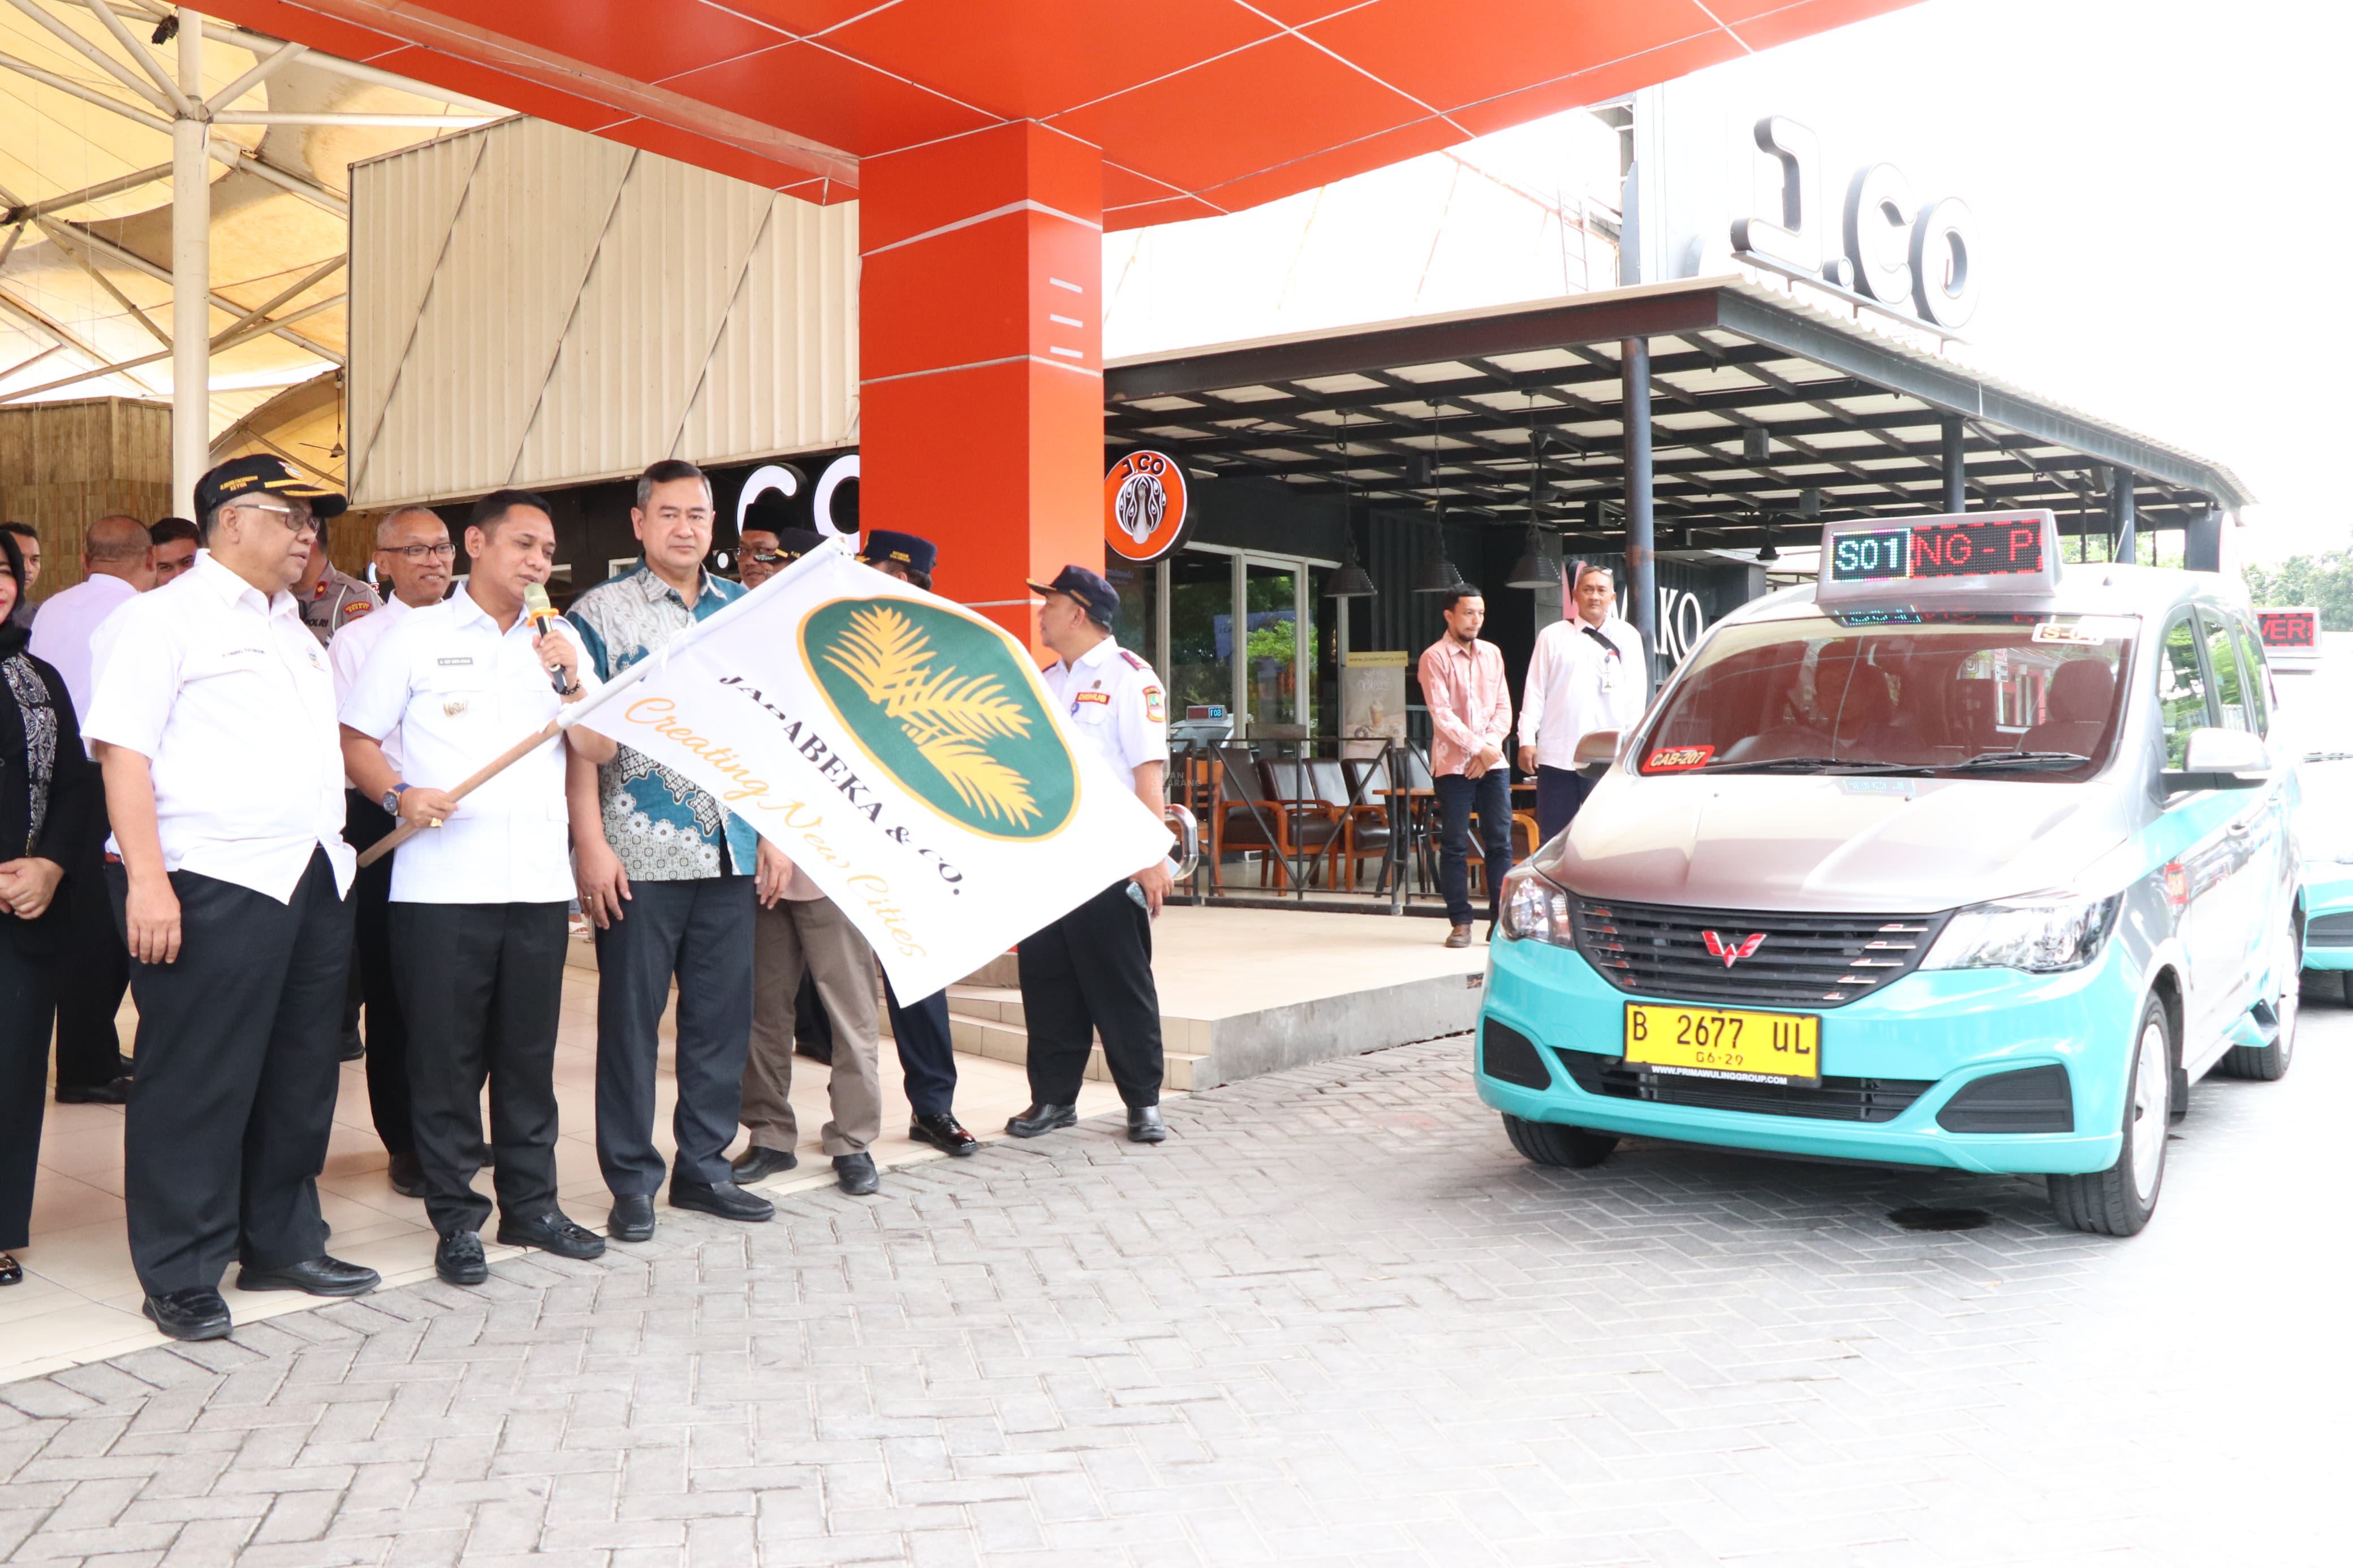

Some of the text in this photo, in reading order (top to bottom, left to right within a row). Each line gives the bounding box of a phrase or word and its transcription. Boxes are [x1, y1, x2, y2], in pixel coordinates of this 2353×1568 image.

[1121, 454, 1166, 480] J.CO
[1835, 538, 1898, 570] S01
[1914, 533, 1971, 566] NG
[2010, 529, 2033, 561] P
[1650, 751, 1706, 767] CAB-207
[625, 697, 927, 957] Creating New Cities
[919, 849, 963, 896] CO.
[1633, 1011, 1810, 1054] B 2677 UL
[1652, 1065, 1787, 1085] WWW.PRIMAWULINGGROUP.COM
